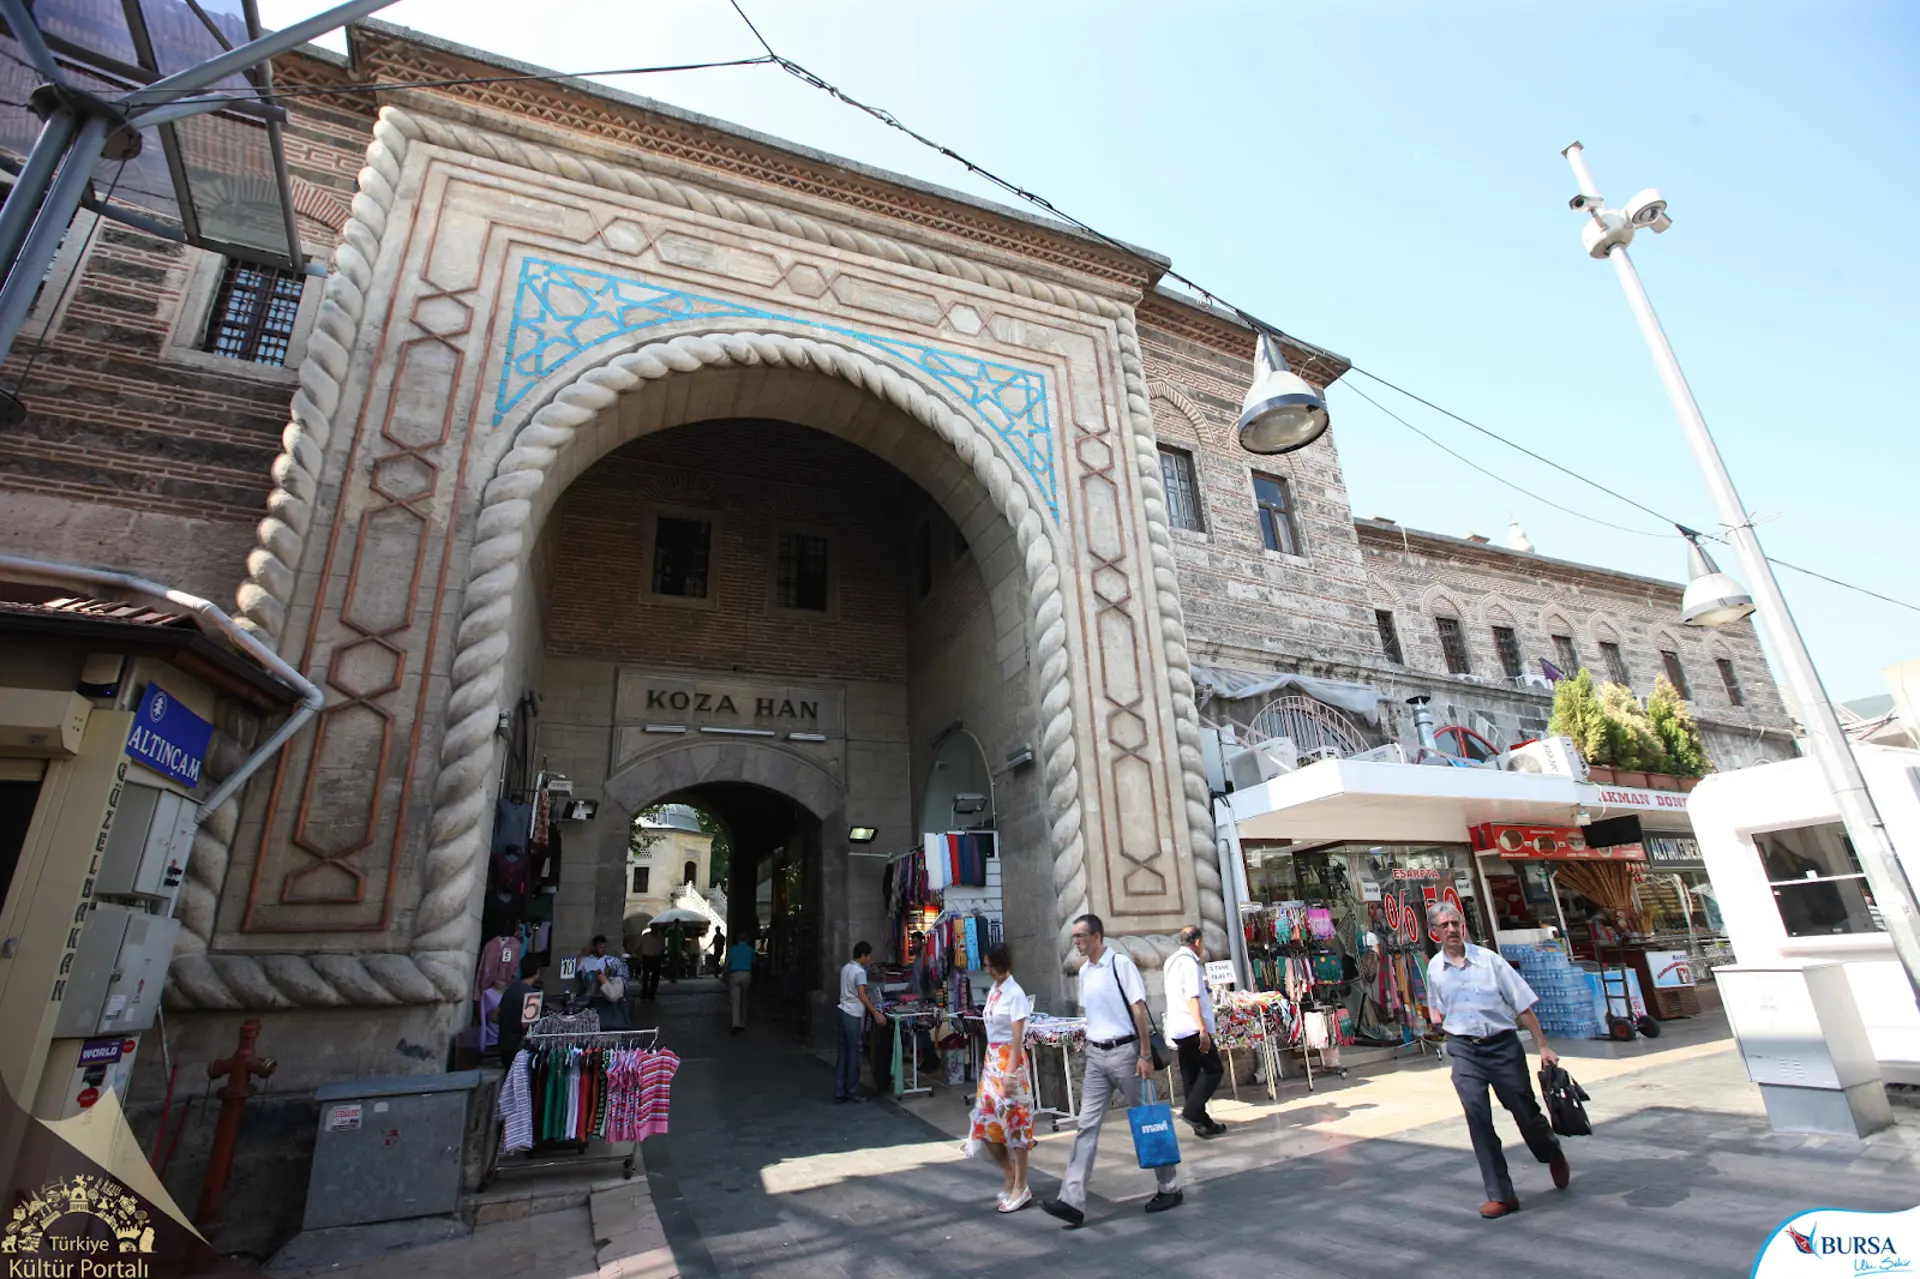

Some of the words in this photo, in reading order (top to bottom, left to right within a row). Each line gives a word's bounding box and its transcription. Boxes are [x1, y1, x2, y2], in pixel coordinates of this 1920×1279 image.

[646, 689, 738, 714] KOZA
[755, 697, 818, 720] HAN
[128, 725, 202, 782] ALTINÇAM
[1599, 791, 1650, 805] AKMAN
[562, 959, 575, 976] 10
[523, 994, 541, 1020] 5
[82, 1046, 119, 1060] WORLD
[1141, 1120, 1169, 1134] mavi
